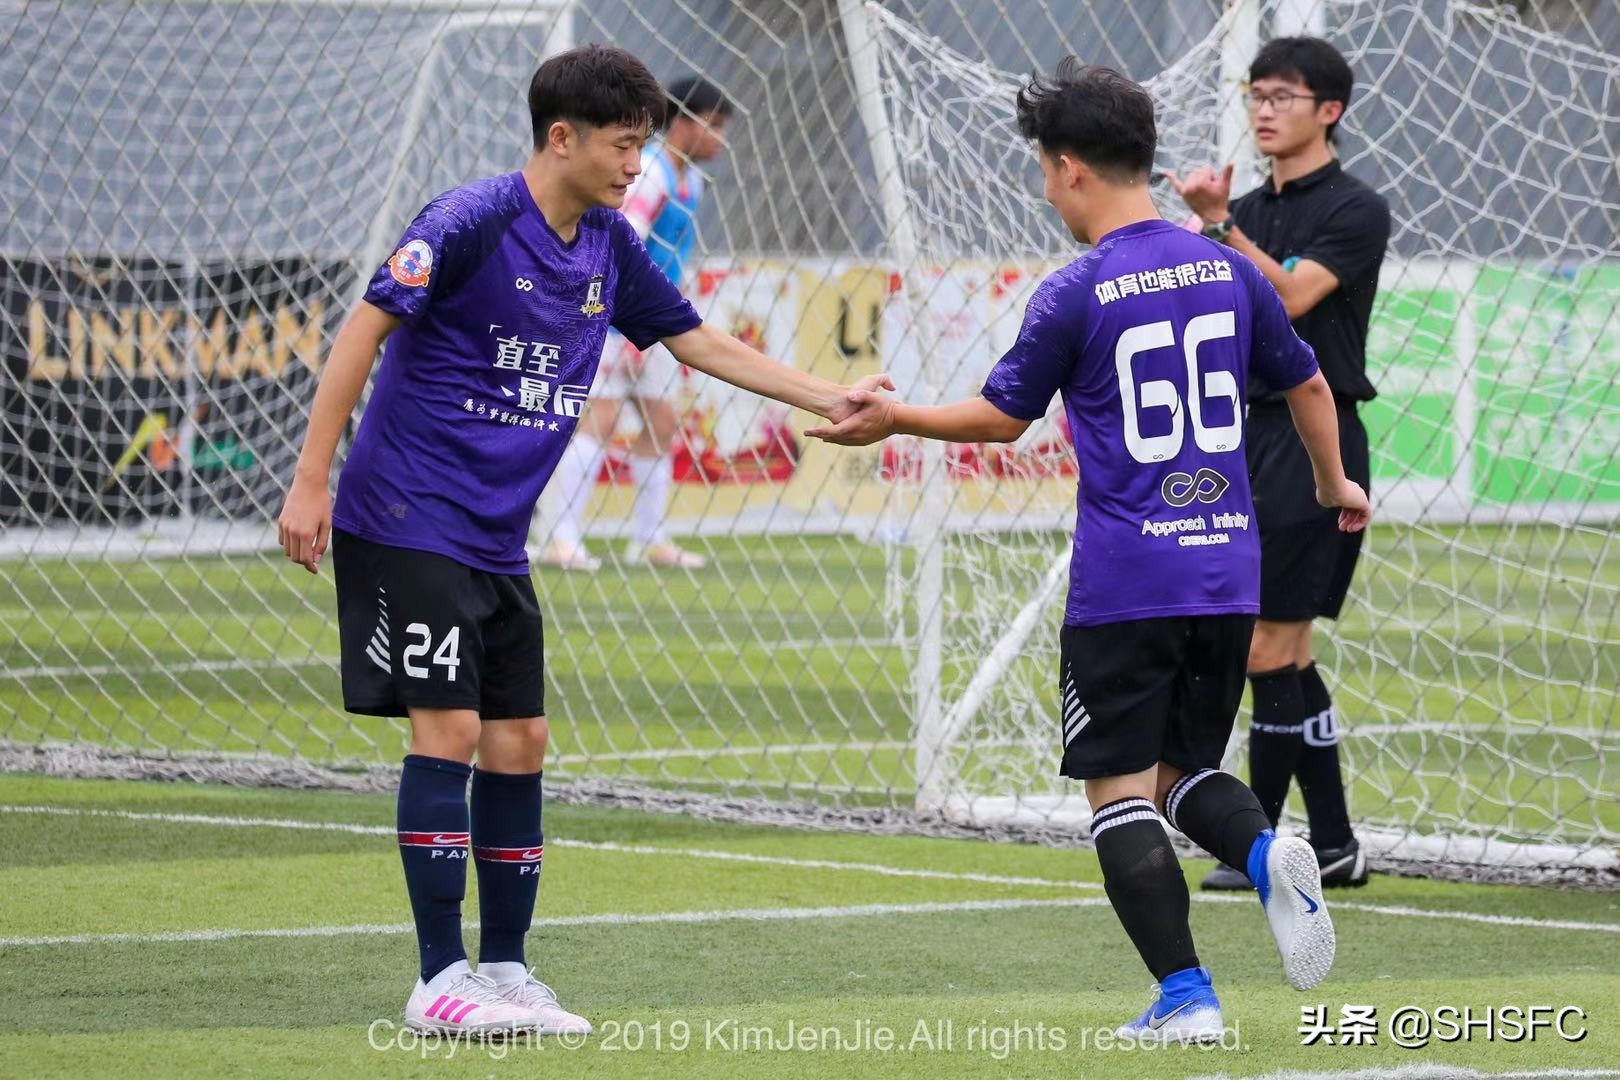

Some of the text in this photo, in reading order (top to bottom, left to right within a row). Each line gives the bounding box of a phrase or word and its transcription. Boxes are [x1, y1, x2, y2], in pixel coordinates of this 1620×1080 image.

[1095, 259, 1233, 305] 体育也能很公益
[27, 299, 325, 382] LINKMAN
[1115, 310, 1242, 464] 66
[1141, 511, 1249, 537] Approach Infinity
[403, 622, 460, 681] 24
